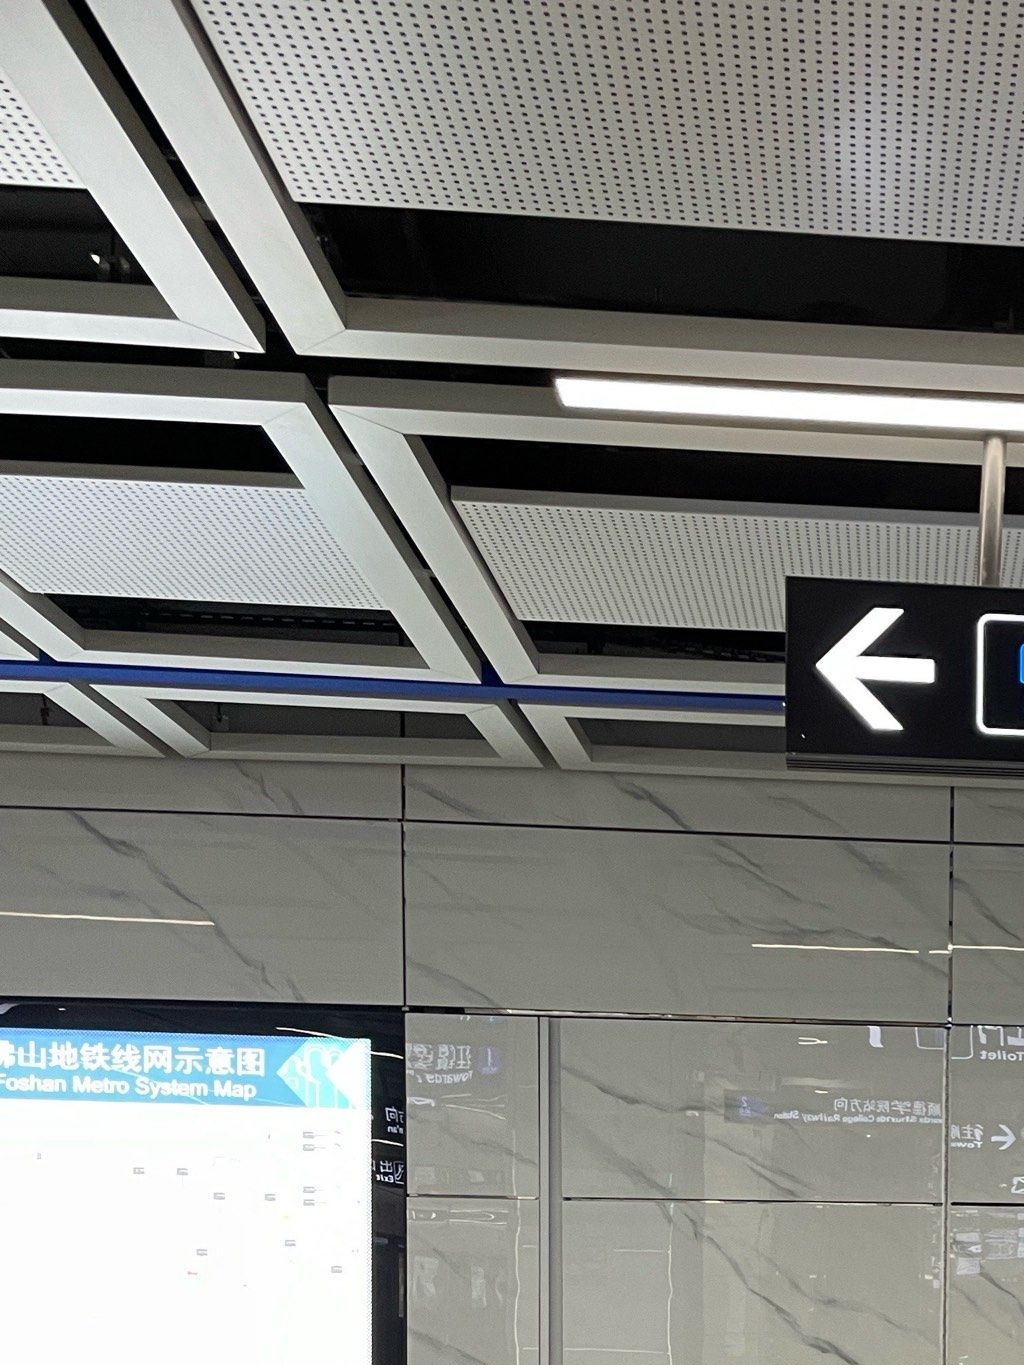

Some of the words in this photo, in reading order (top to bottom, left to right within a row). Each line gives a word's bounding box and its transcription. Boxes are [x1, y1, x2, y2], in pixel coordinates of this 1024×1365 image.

[72, 1075, 131, 1095] Metro
[135, 1077, 208, 1099] System
[213, 1080, 256, 1102] Map
